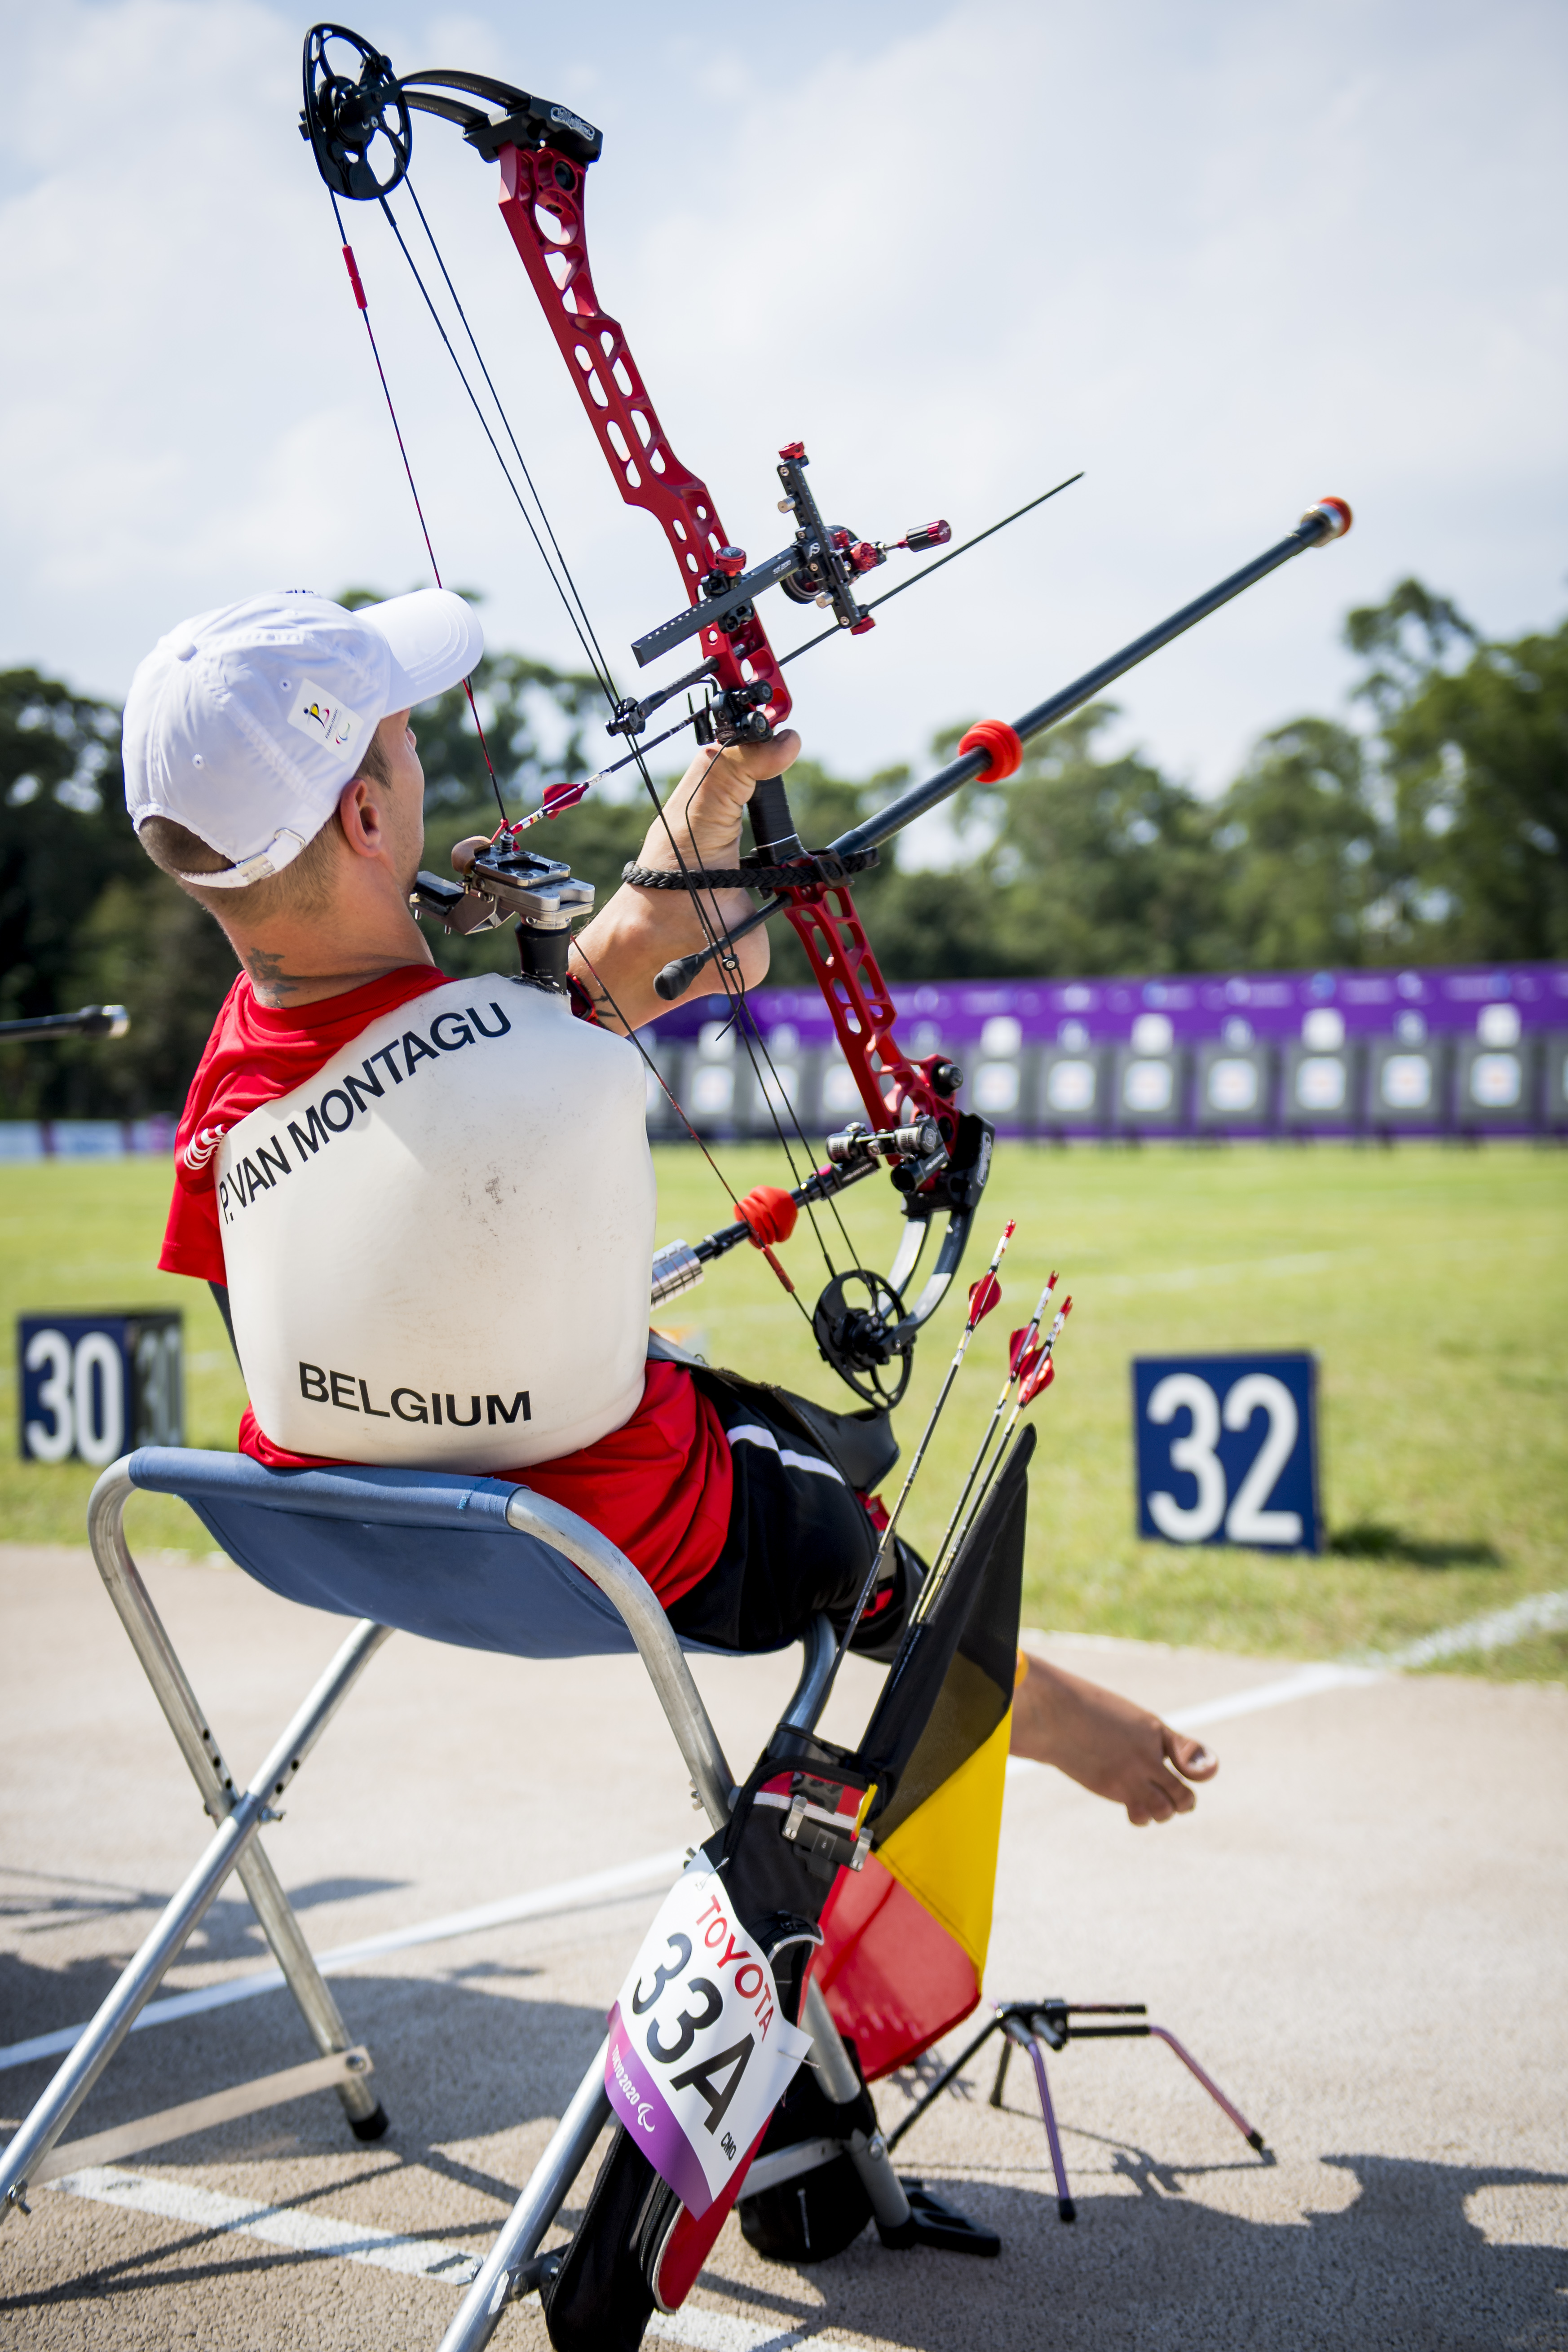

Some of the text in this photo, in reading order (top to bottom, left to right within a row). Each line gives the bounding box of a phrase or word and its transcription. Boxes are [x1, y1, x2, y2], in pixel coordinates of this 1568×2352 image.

[227, 1134, 292, 1208] VAN
[287, 1002, 512, 1162] MONTAGU
[25, 1328, 125, 1465] 30
[299, 1361, 531, 1427] BELGIUM
[1146, 1372, 1303, 1543] 32
[633, 1933, 755, 2135] 33A
[696, 1894, 774, 2042] TOYOTA
[613, 2044, 640, 2105] TOKYO 2020
[720, 2131, 736, 2161] CMO
